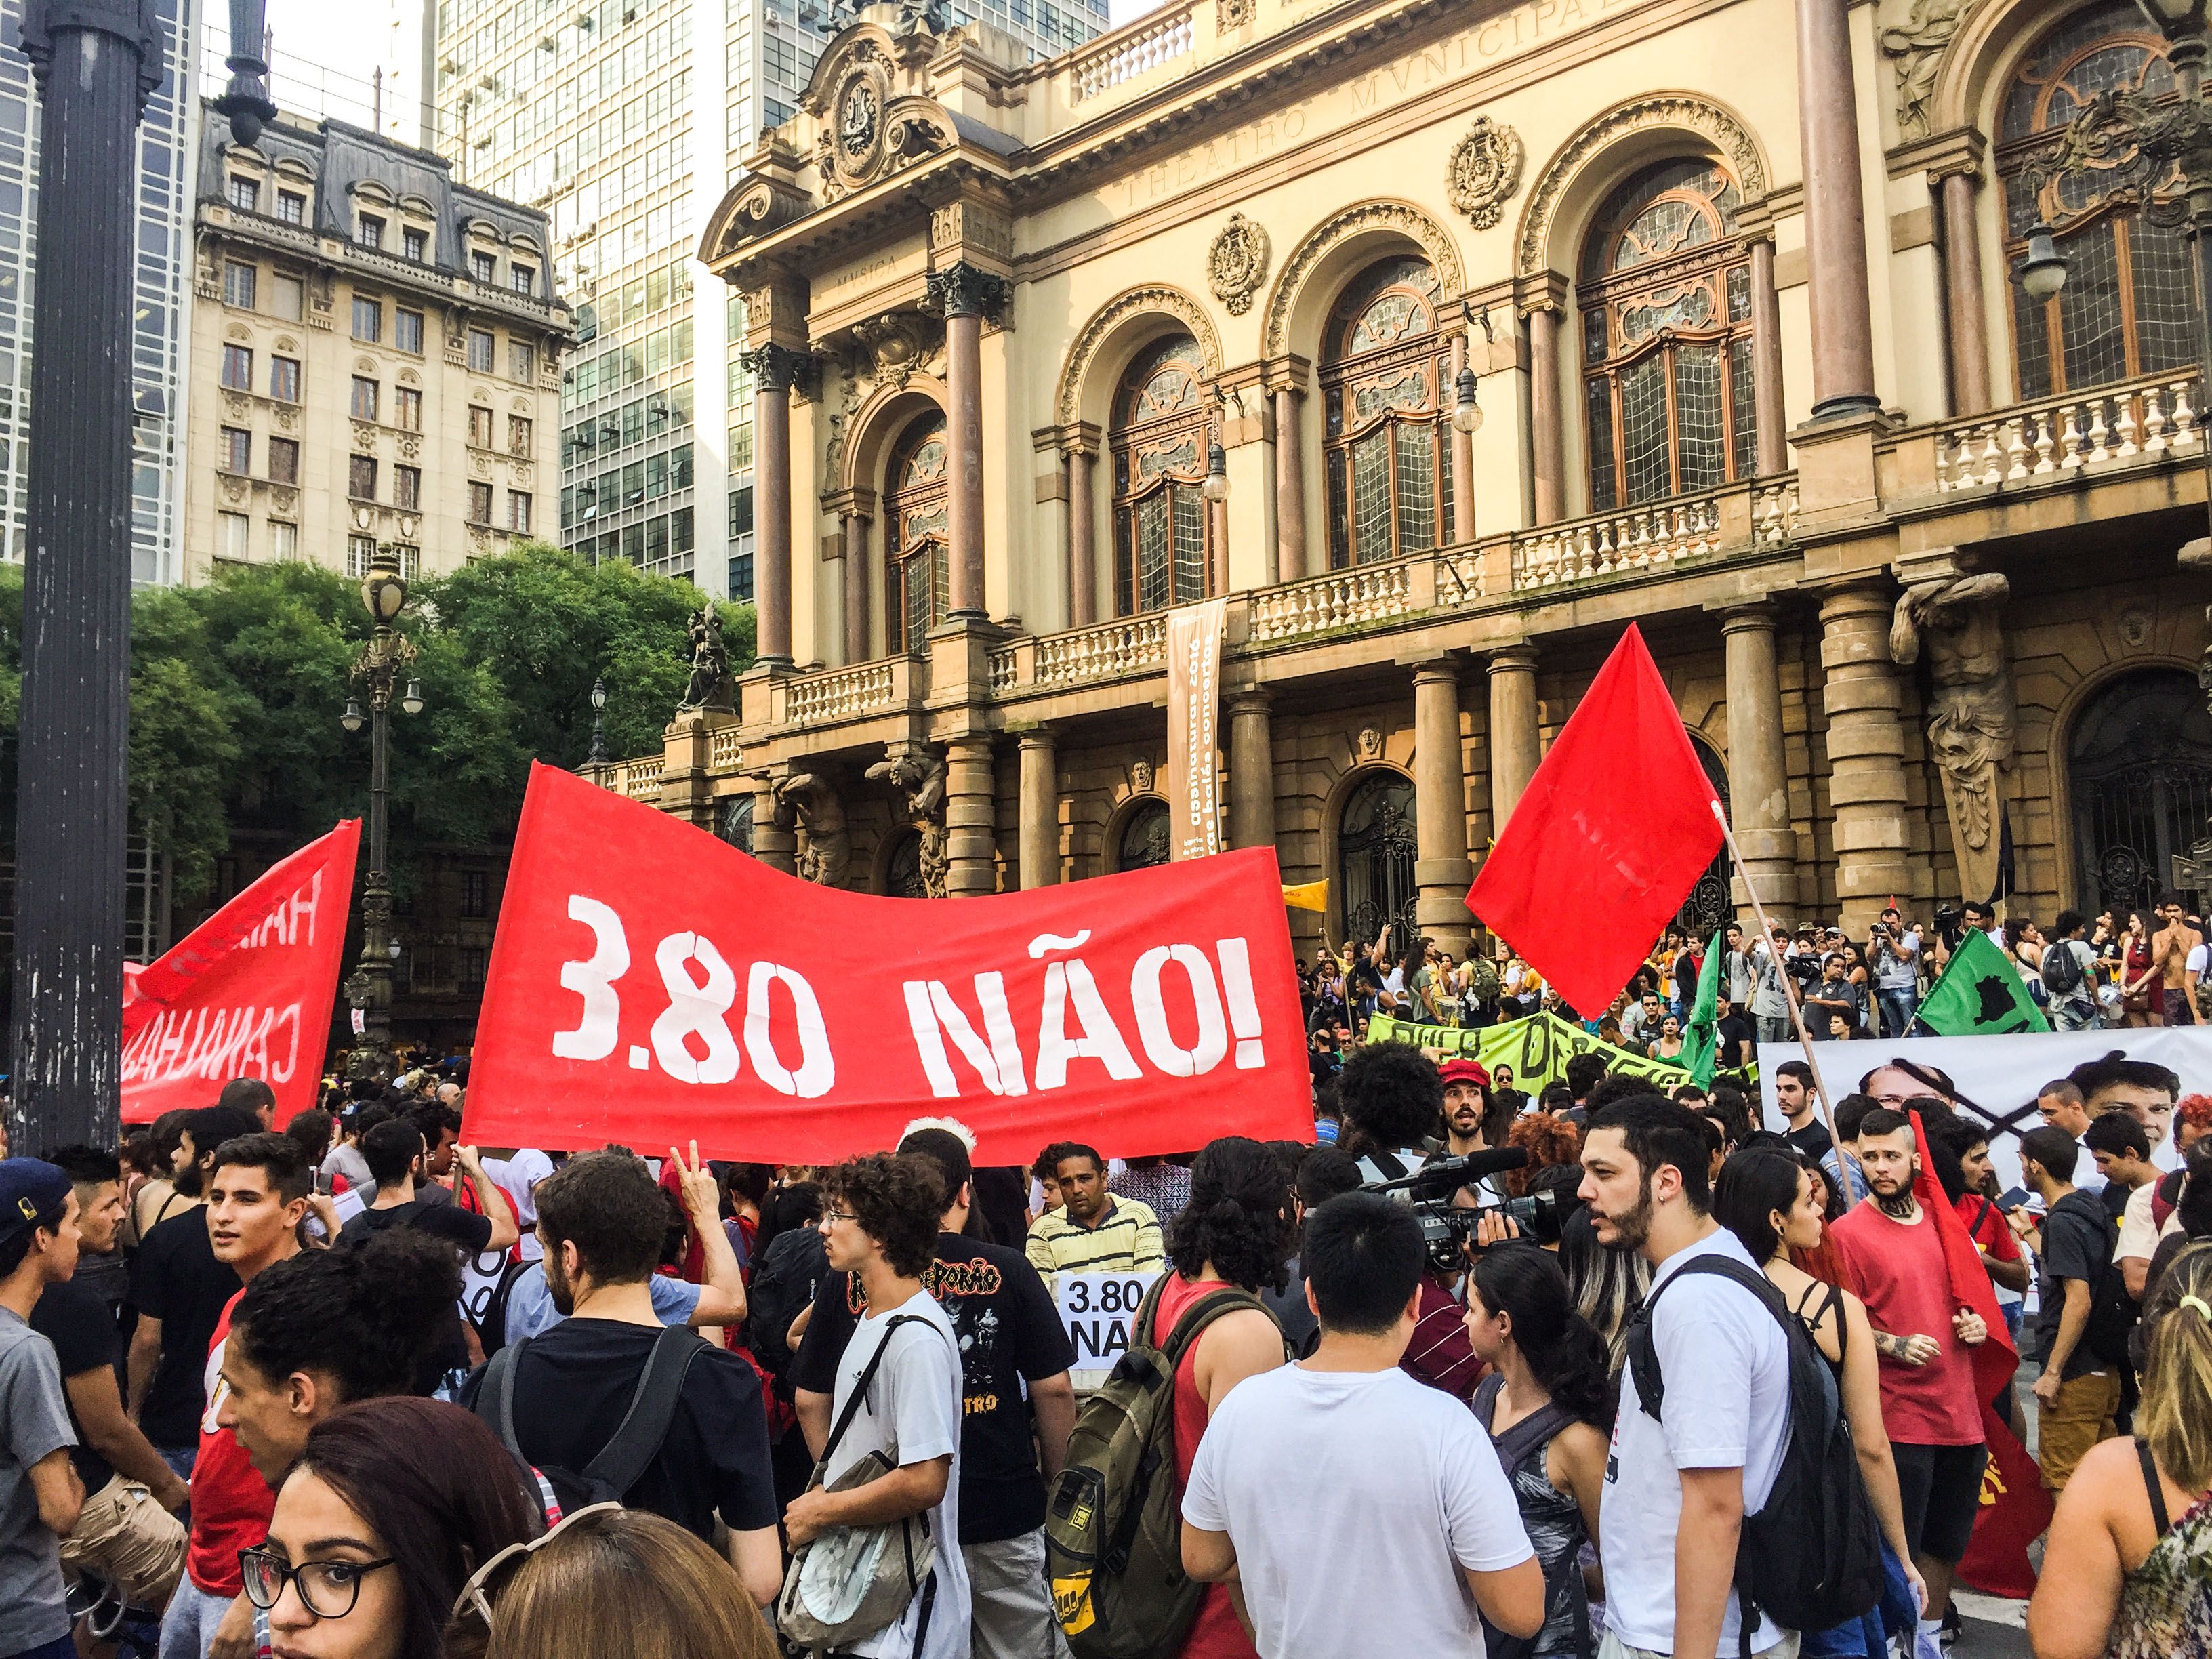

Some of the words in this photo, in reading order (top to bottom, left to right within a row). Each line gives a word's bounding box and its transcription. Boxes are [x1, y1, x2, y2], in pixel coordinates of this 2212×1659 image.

[1122, 109, 1307, 207] THEATRO
[1351, 0, 1628, 114] MVNICIPA
[836, 255, 898, 295] MVSICA
[1189, 638, 1200, 687] 2016
[1201, 634, 1214, 745] concertos
[1189, 693, 1202, 826] assinaturas
[1200, 751, 1213, 814] balés
[552, 893, 835, 1099] 3.80
[902, 928, 1266, 1098] NÃO!
[1068, 1279, 1144, 1313] 3.80
[1071, 1317, 1130, 1357] NÃ
